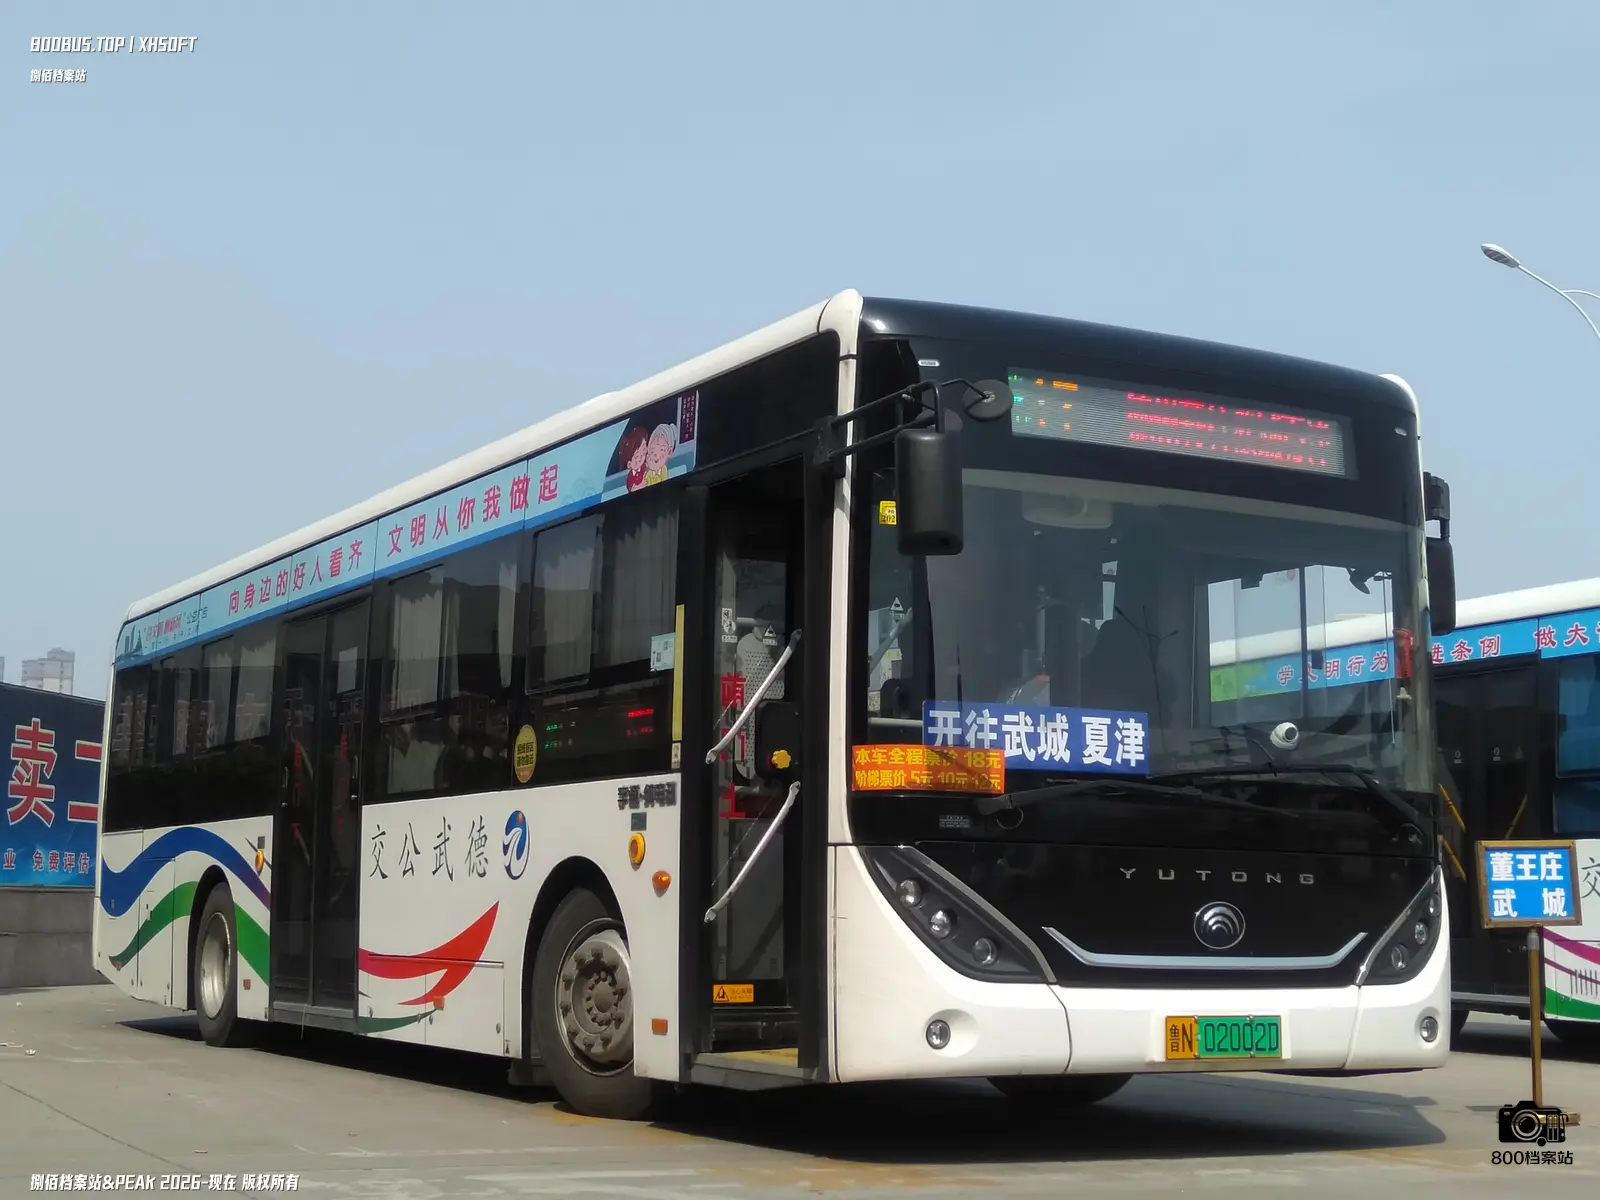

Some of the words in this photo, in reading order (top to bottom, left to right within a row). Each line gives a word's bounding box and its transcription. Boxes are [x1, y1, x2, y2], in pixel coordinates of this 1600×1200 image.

[387, 464, 559, 557] 文明从你我做起
[228, 540, 363, 616] 向身边的好人看齐
[1534, 623, 1600, 650] 做大
[927, 709, 1071, 763] 开往武城
[1081, 716, 1145, 767] 夏津
[963, 751, 1001, 768] 18元
[855, 769, 907, 788] 阶梯票价
[910, 771, 933, 787] 5元
[937, 772, 968, 786] 10元
[3, 849, 16, 870] 业
[32, 850, 90, 874] 免费评估
[1489, 851, 1564, 881] 董王庄
[1119, 867, 1315, 885] YUTONG
